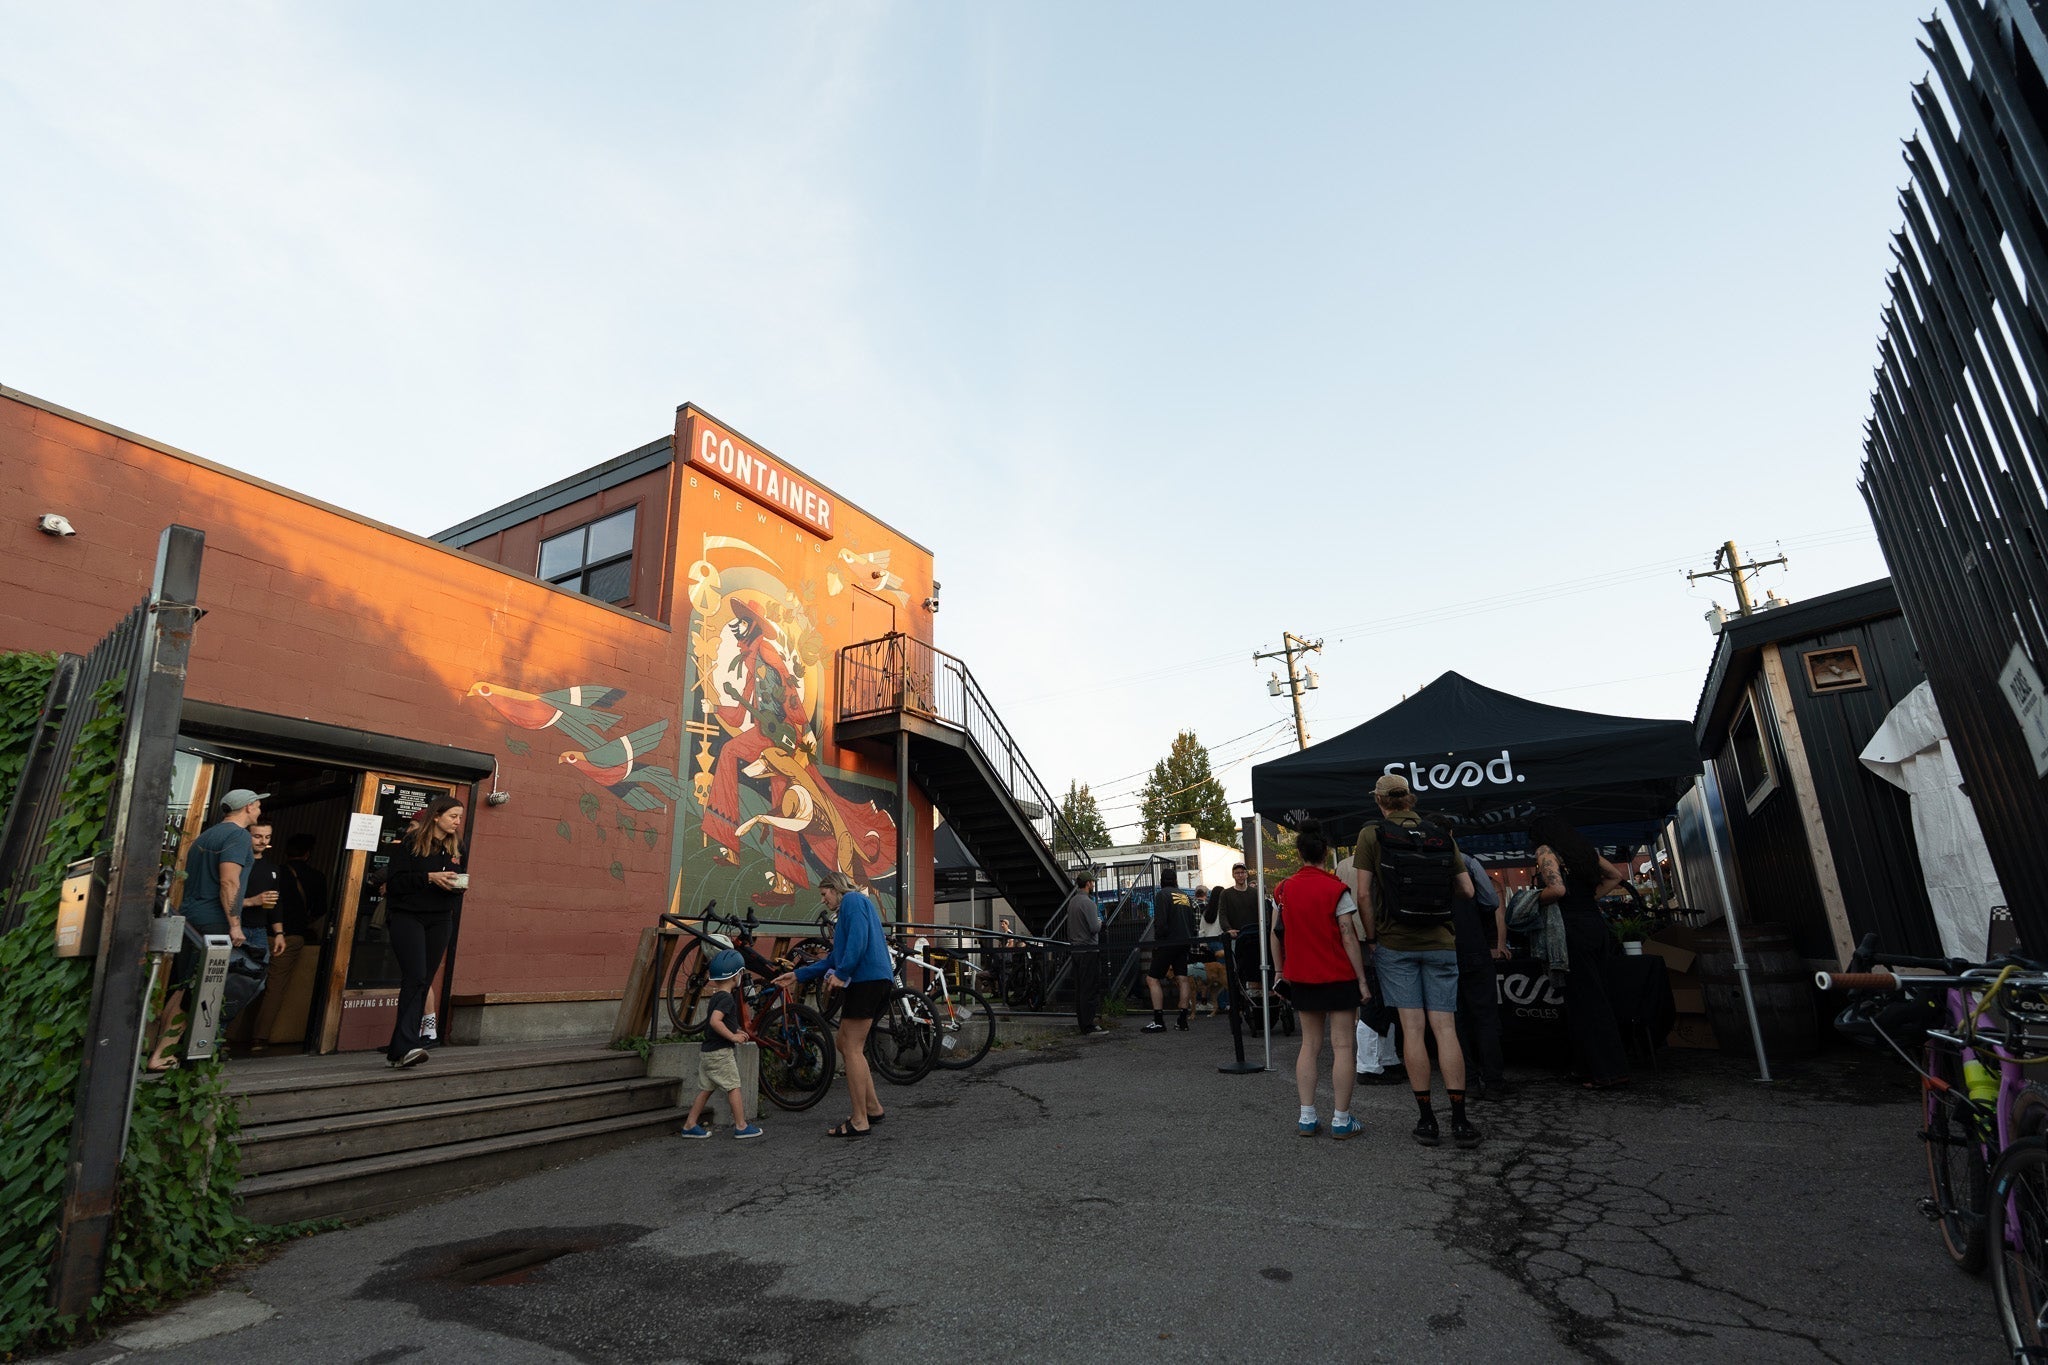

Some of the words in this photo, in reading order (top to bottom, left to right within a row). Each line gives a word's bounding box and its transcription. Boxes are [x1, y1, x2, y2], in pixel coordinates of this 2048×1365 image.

[701, 429, 830, 529] CONTAINER
[689, 476, 822, 553] BREWING
[208, 967, 225, 975] YOUR
[204, 975, 223, 983] BUTTS
[344, 1000, 376, 1008] SHIPPING
[386, 998, 398, 1006] REC
[1515, 1007, 1559, 1019] CYCLES
